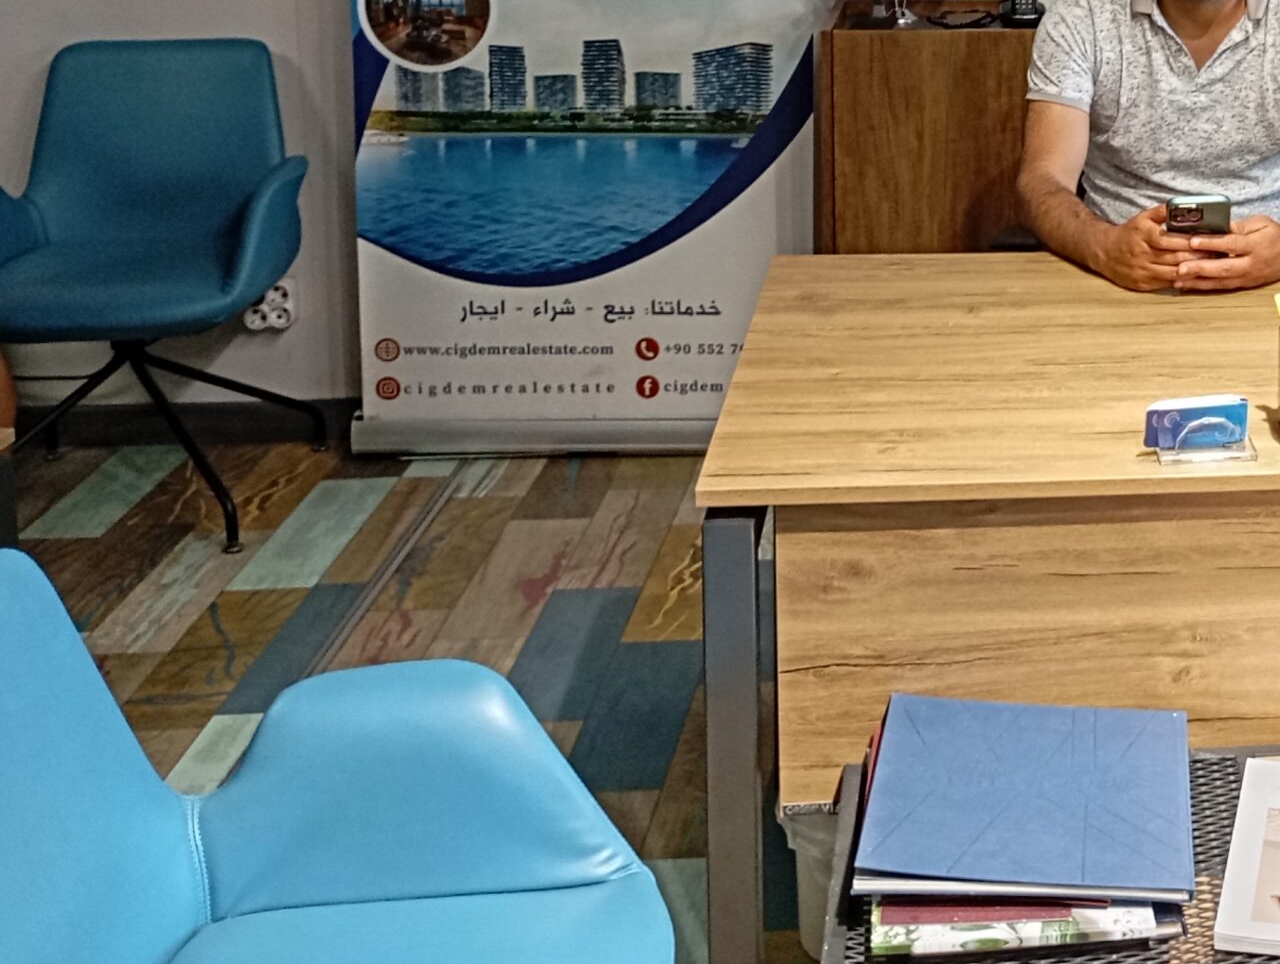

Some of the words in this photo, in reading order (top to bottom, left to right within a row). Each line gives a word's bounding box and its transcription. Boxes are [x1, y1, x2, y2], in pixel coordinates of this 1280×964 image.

[532, 298, 576, 322] شراء
[603, 303, 635, 323] بيع
[402, 342, 614, 359] www.cigdemrealestate.com
[664, 343, 692, 355] +90
[697, 343, 724, 356] 552
